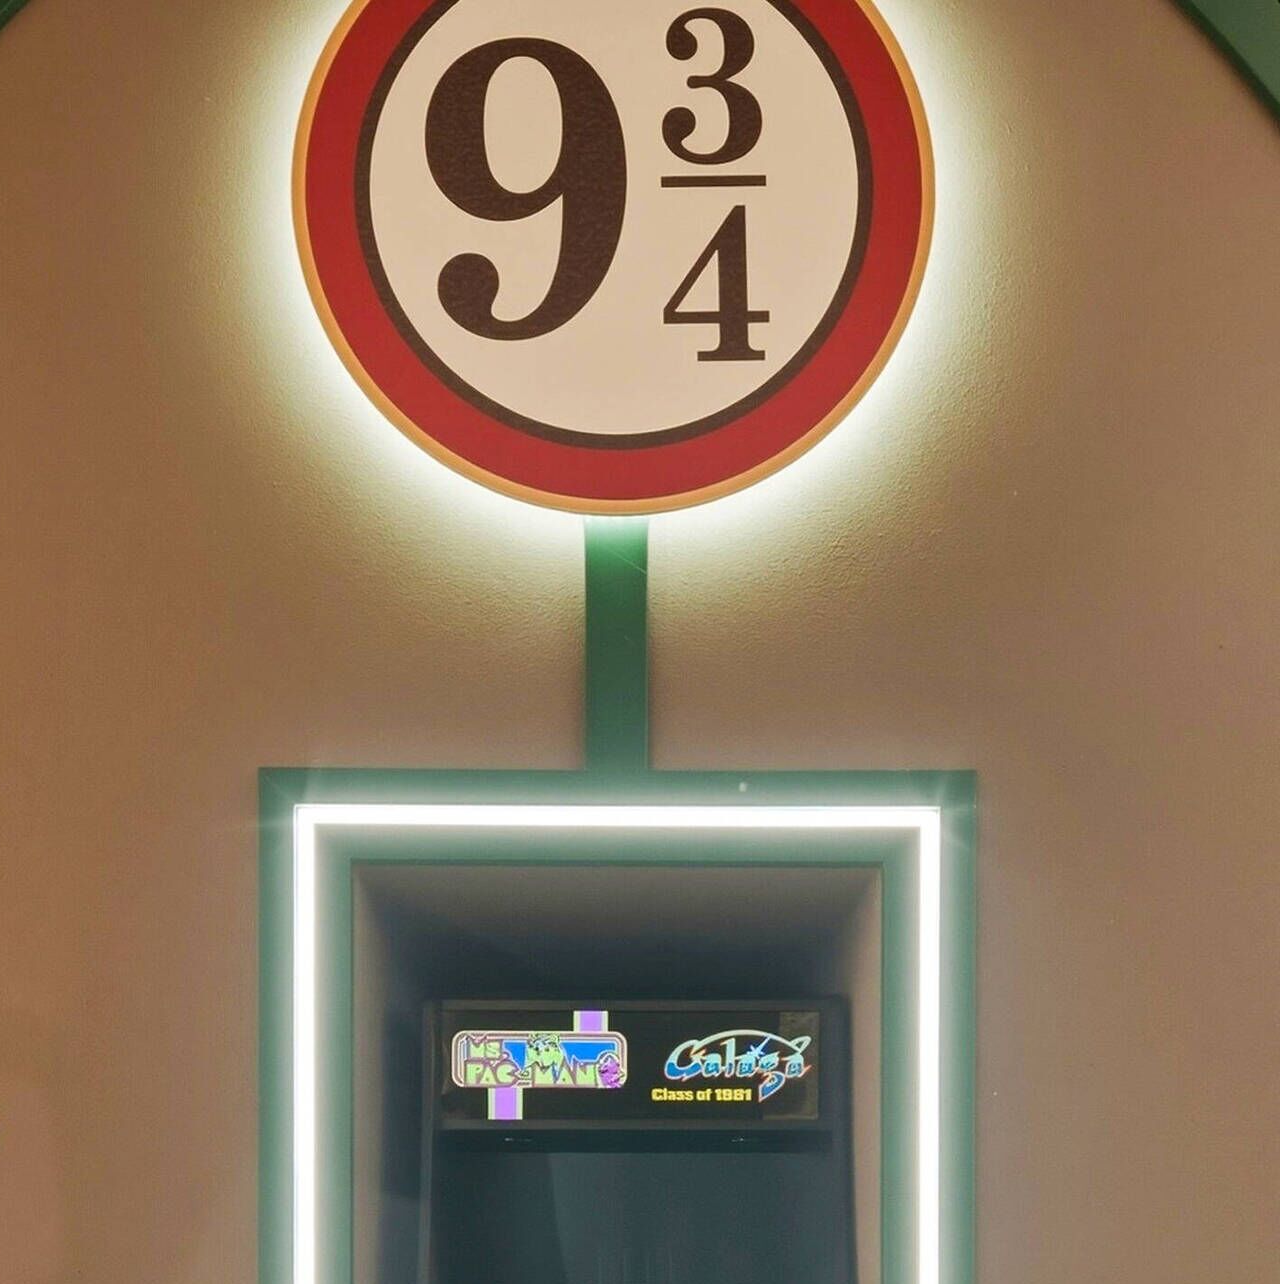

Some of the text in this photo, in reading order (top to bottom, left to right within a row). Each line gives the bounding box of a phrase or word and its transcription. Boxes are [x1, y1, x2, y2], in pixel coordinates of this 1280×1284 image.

[425, 36, 627, 342] 9
[651, 1087, 694, 1102] Class
[696, 1088, 712, 1102] of
